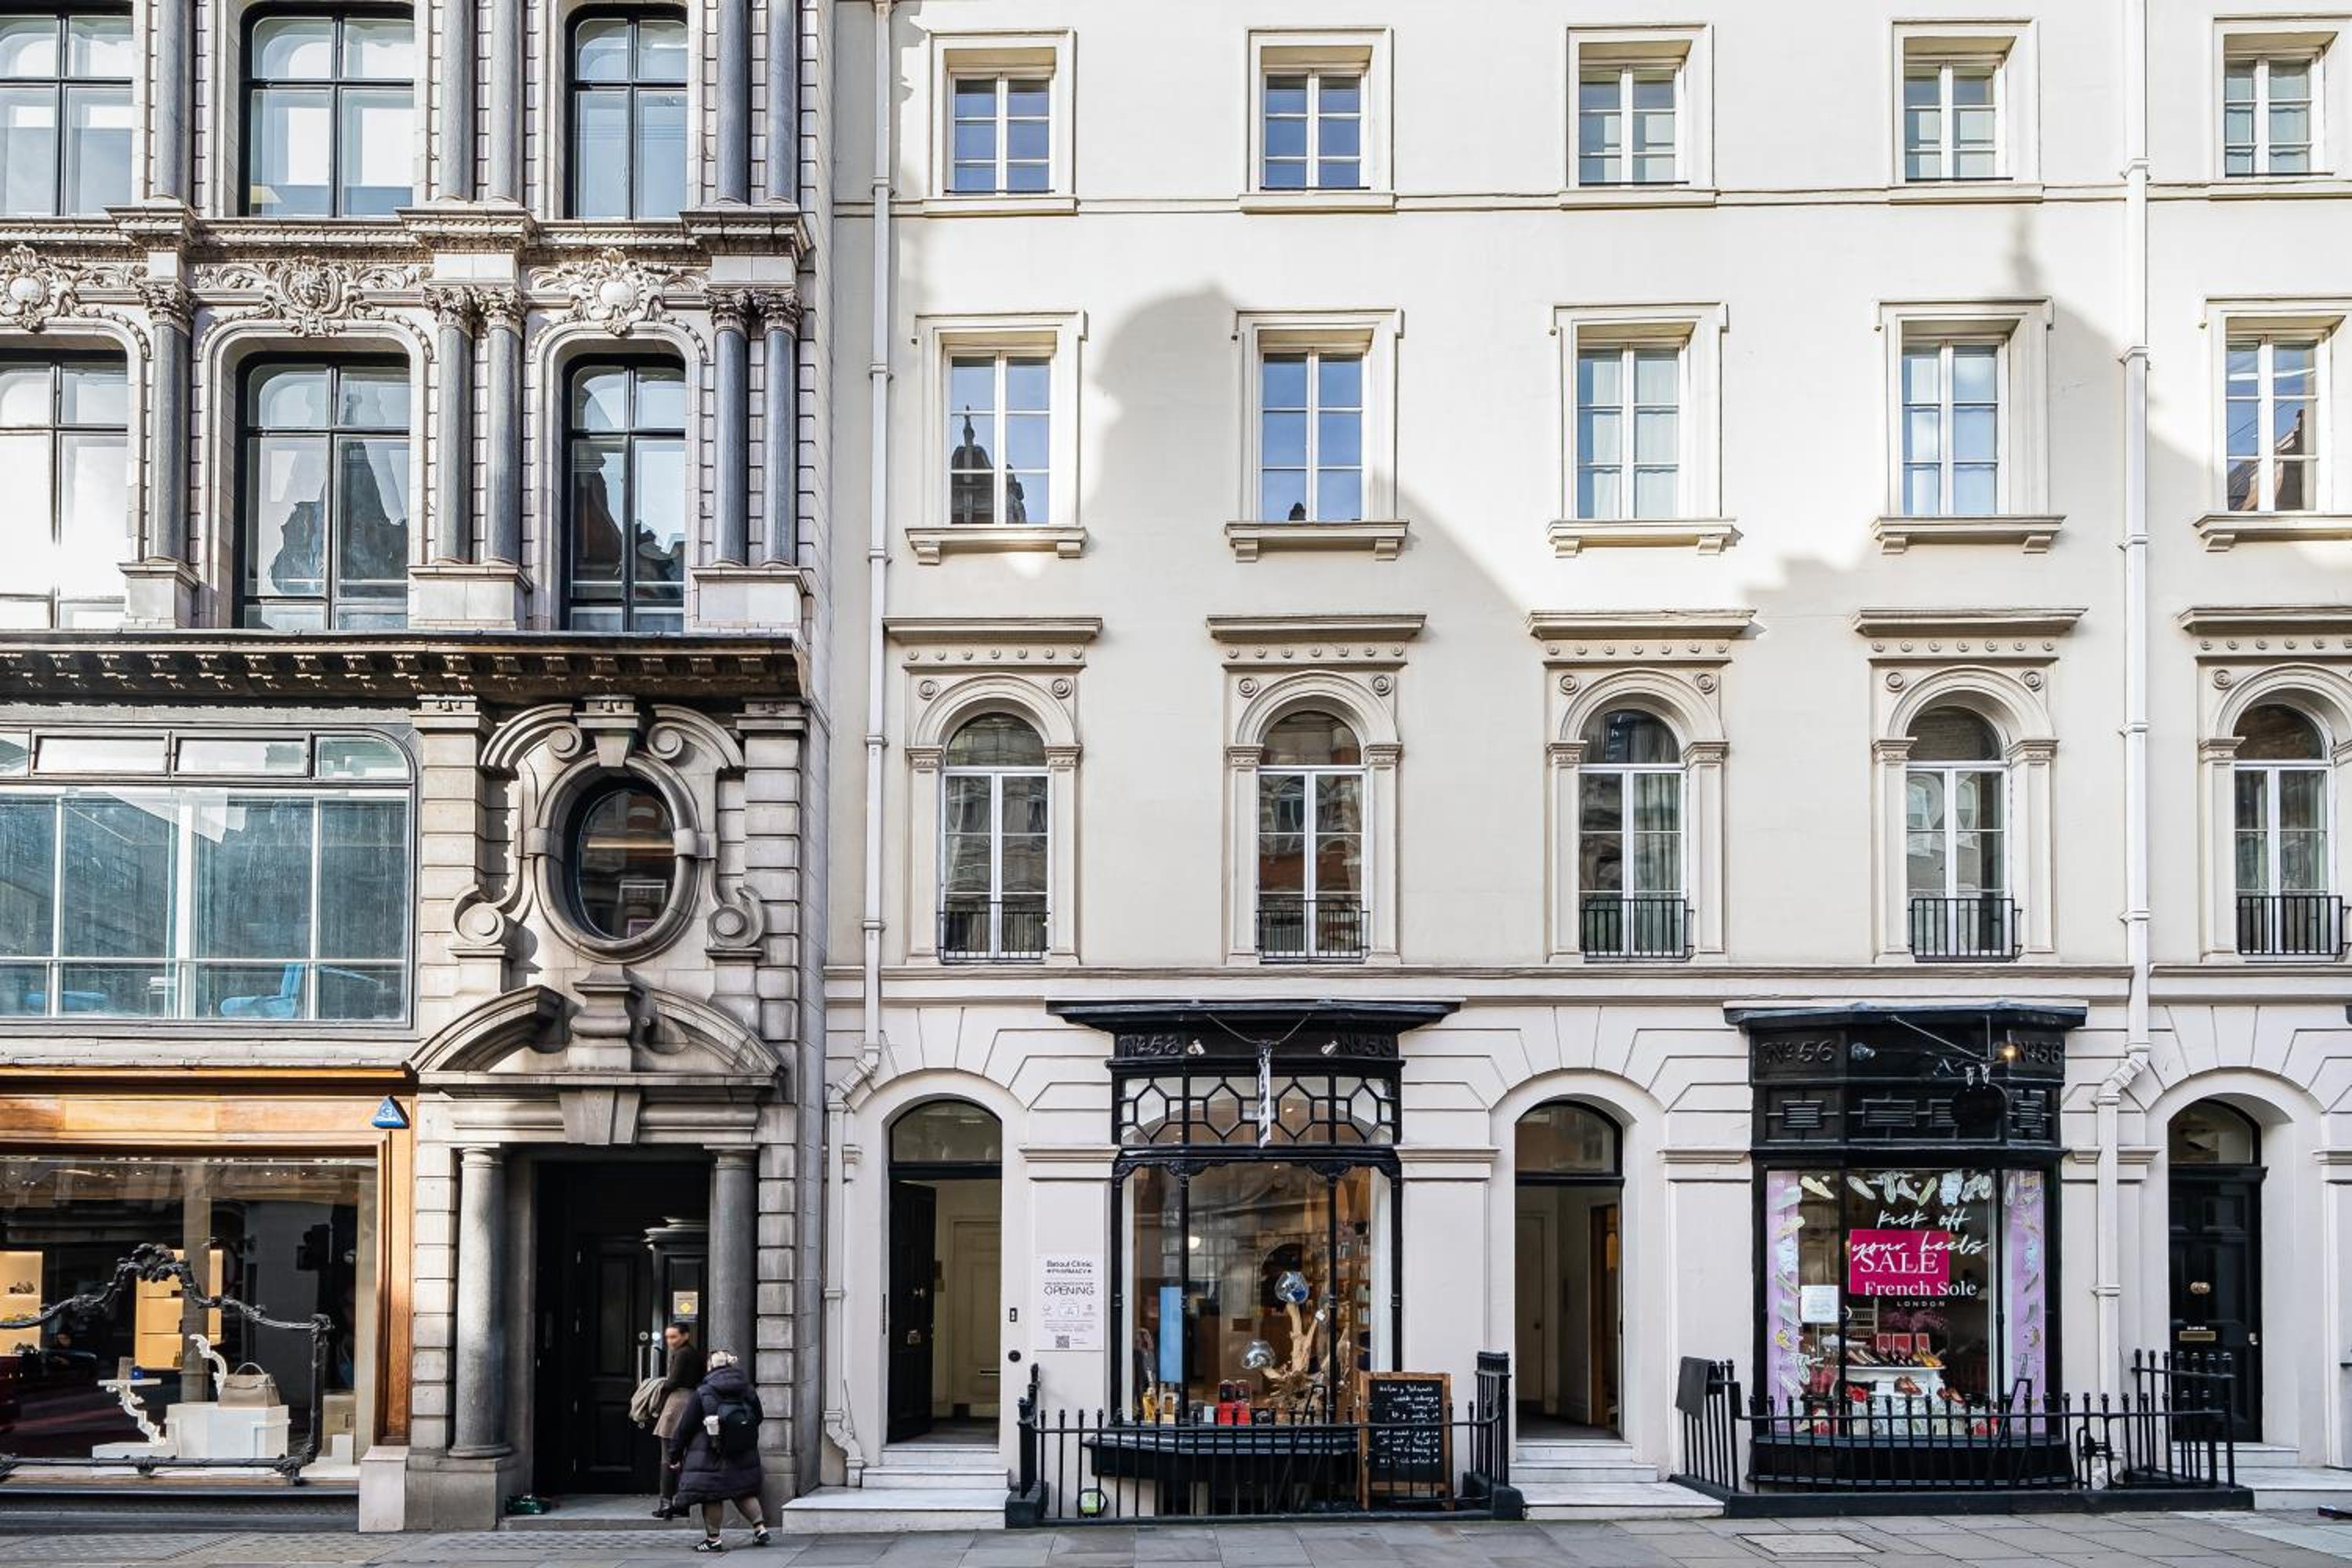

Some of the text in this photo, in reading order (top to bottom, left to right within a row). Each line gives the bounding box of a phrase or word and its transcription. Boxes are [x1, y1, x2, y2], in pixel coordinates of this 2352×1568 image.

[1798, 1040, 1834, 1062] 56
[1939, 1207, 1973, 1232] off
[1852, 1231, 1990, 1261] your heels
[1859, 1250, 1940, 1275] SALE
[1044, 1286, 1095, 1296] OPENING
[1865, 1280, 1977, 1297] French Sole
